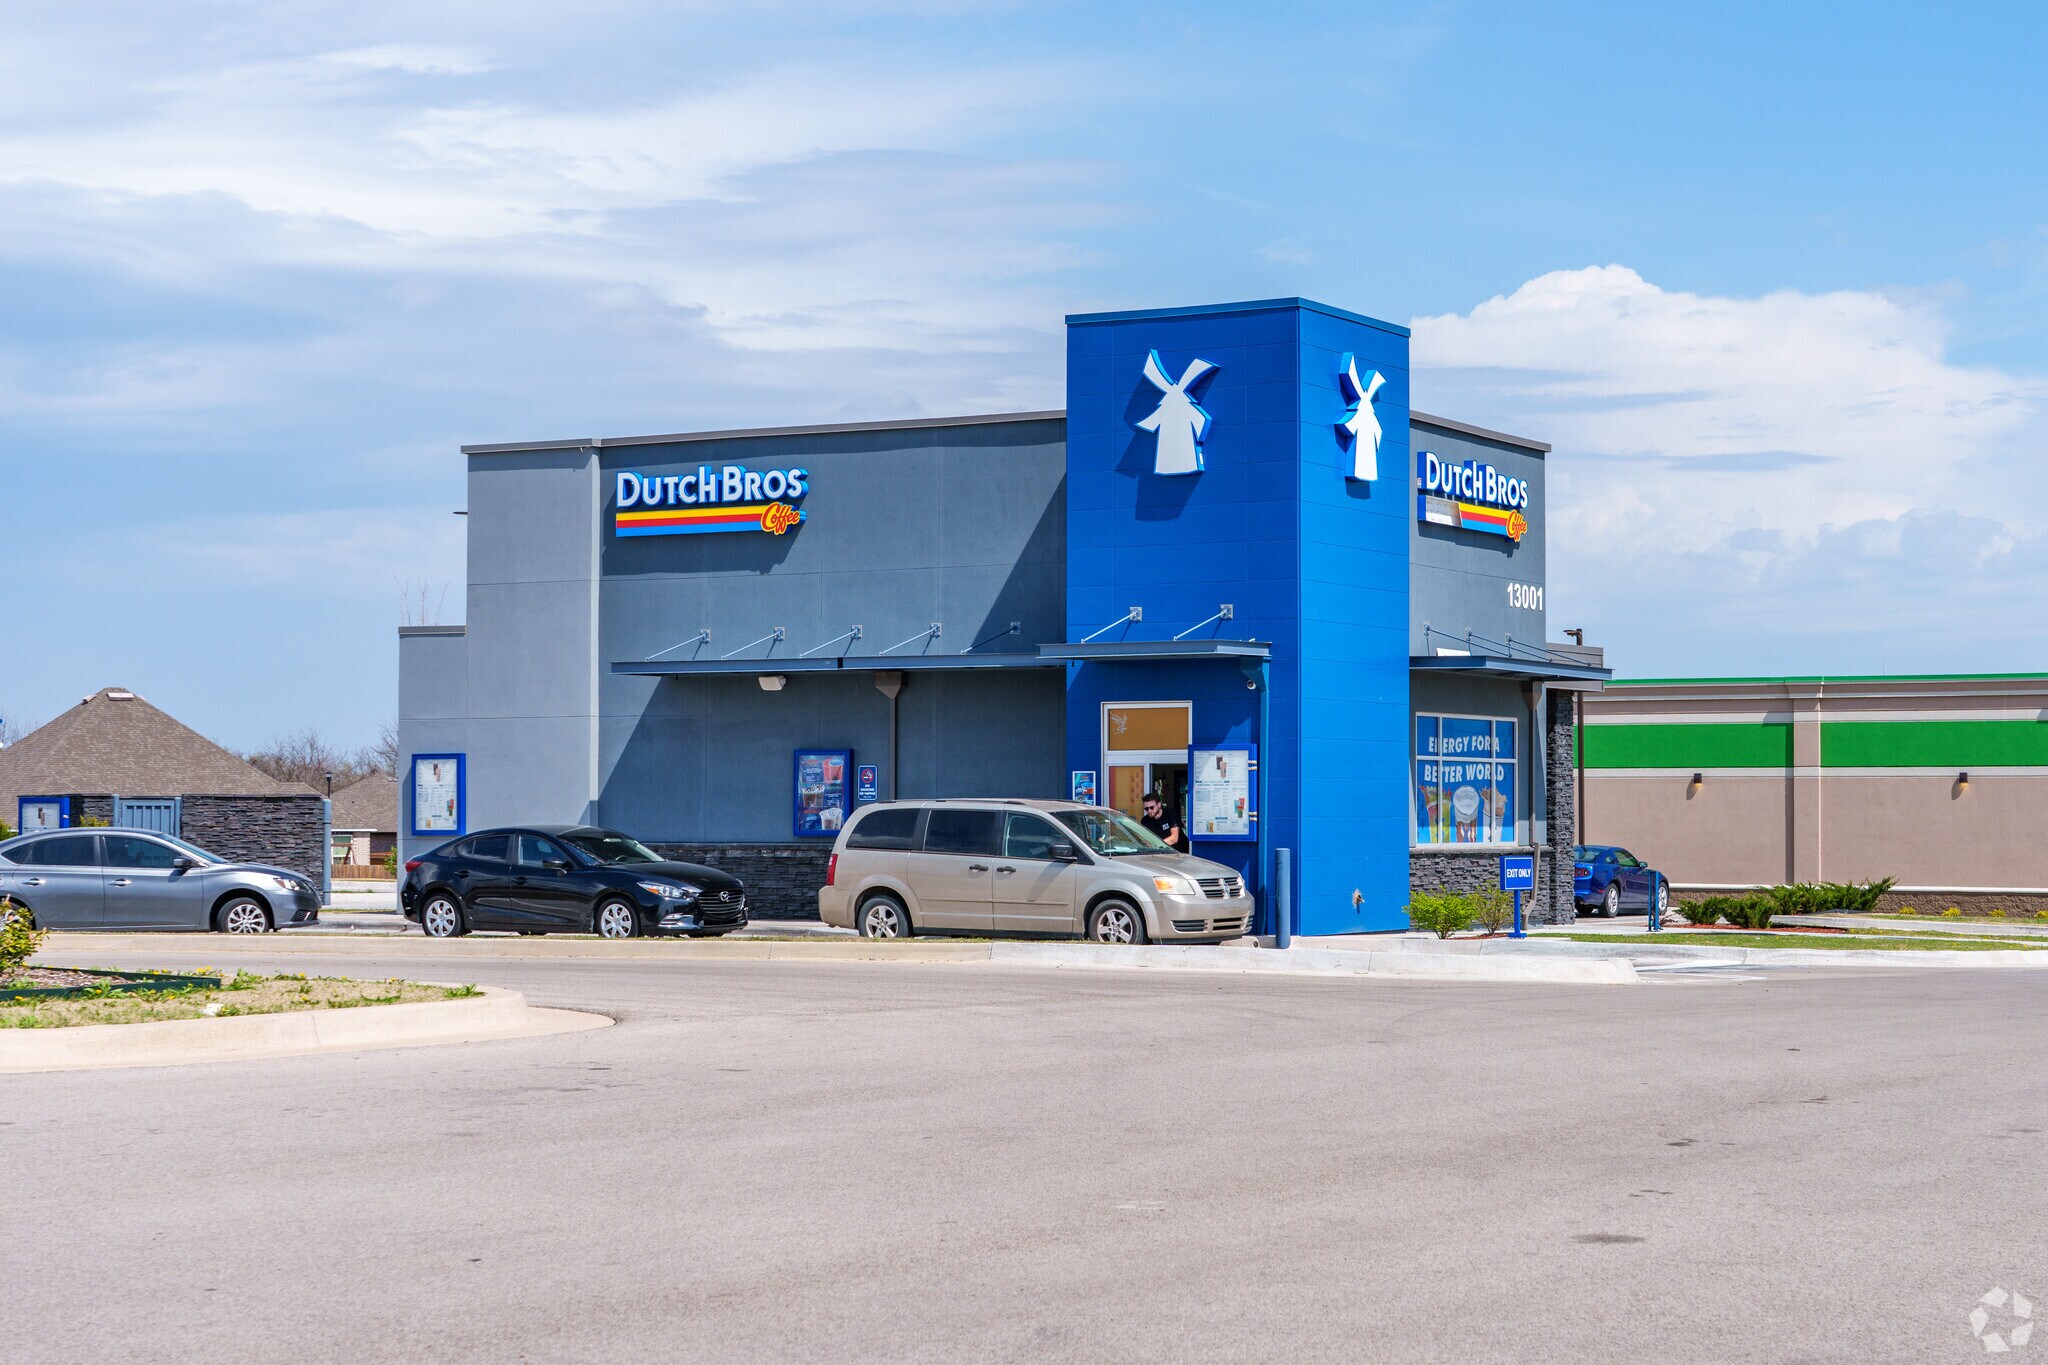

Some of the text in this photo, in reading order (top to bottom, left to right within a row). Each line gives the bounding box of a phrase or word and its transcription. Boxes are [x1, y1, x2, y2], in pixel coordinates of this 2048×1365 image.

[722, 465, 804, 502] BROS
[1486, 465, 1528, 508] BROS
[761, 502, 801, 535] Coffee
[1507, 511, 1527, 542] Coffee
[1508, 582, 1543, 611] 13001
[1471, 735, 1491, 751] FOR
[1466, 764, 1504, 781] WORD
[1507, 869, 1531, 878] EXIT ONLY
